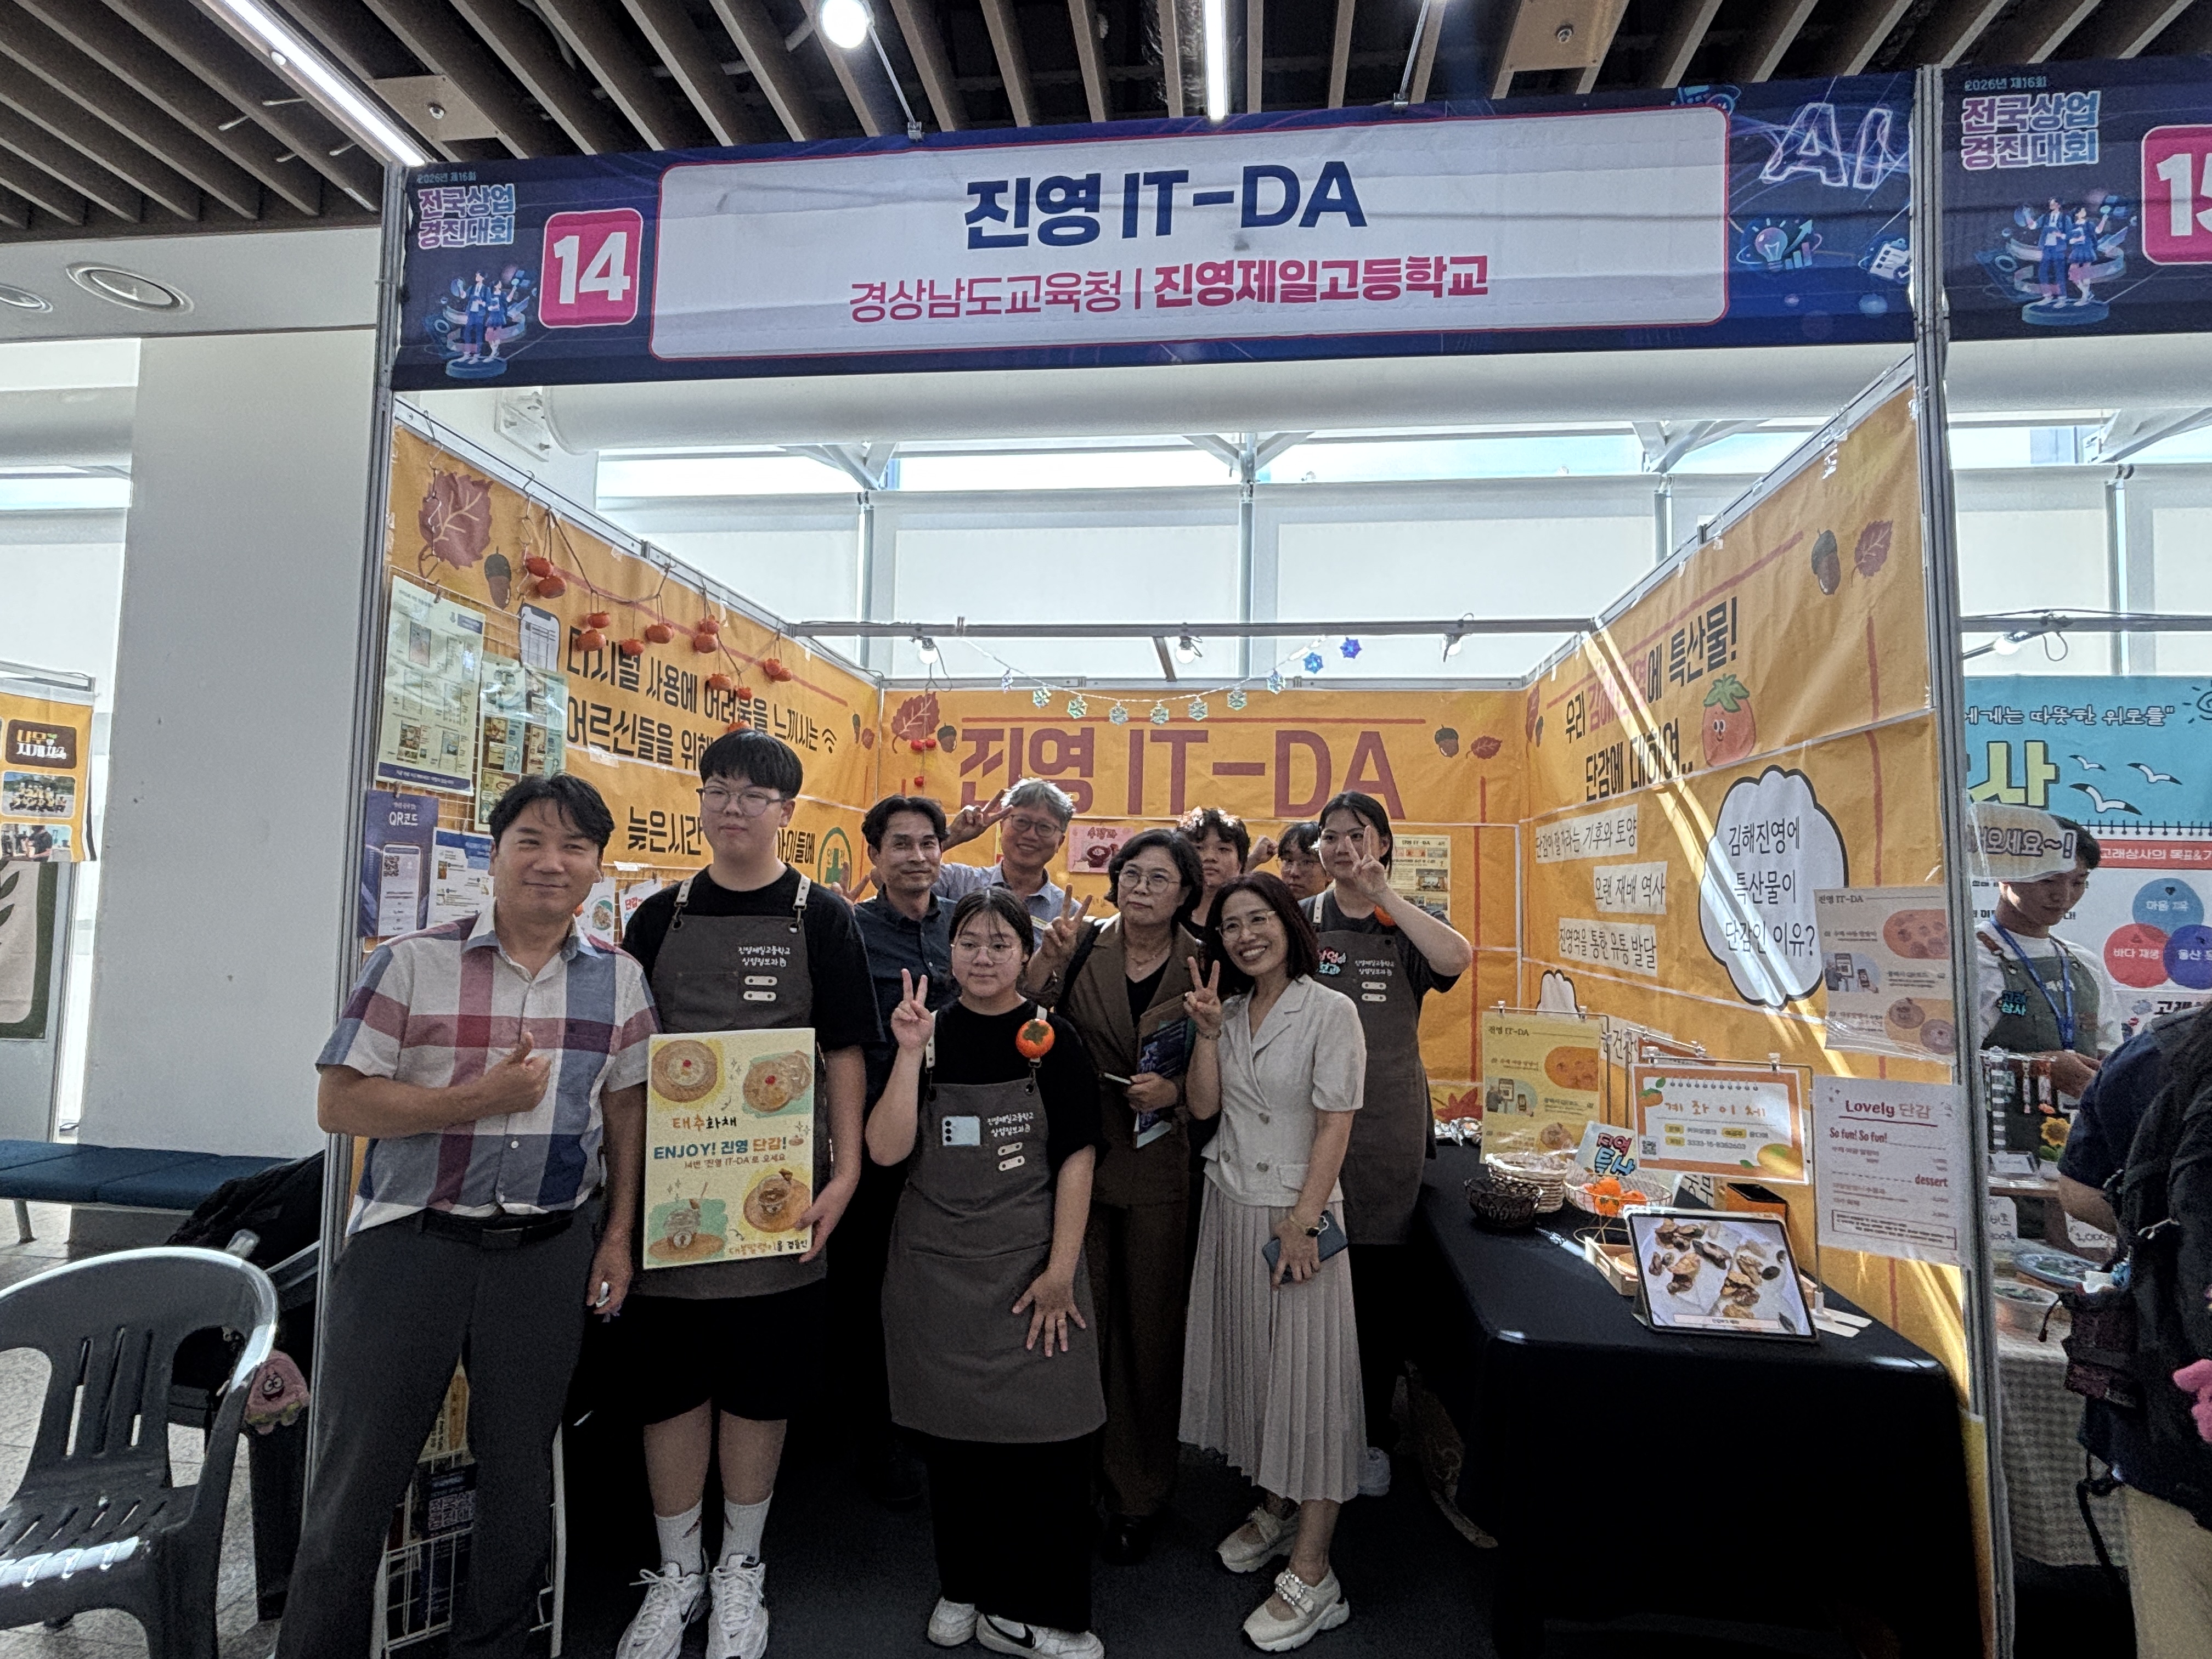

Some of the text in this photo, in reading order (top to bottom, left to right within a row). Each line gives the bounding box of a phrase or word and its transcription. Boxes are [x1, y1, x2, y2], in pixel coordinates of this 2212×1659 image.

[1962, 91, 2101, 134] 전국상업
[1961, 129, 2100, 170] 경진대회
[417, 183, 515, 219] 전국상업
[964, 161, 1368, 250] 진영 IT-DA
[418, 216, 514, 249] 경진대회
[553, 232, 631, 305] 14
[849, 255, 1489, 324] 경상남도교육청 진영제일고등학교
[1566, 691, 1585, 743] 우리
[1669, 596, 1737, 687] 특산물!
[646, 656, 697, 714] 사용에
[774, 704, 818, 752] 느끼시는
[2030, 704, 2097, 725] 따뜻한
[567, 696, 674, 766] 어르신들을
[960, 727, 1406, 820] 진영 IT-DA
[1586, 742, 1624, 802] 단감에
[389, 811, 418, 826] QR코드
[1728, 815, 1800, 857] 김해진영에
[1536, 832, 1554, 858] 단감이
[1561, 827, 1581, 853] 자라는
[1583, 819, 1613, 850] 기후와
[1615, 815, 1637, 848] 토양
[2101, 848, 2166, 860] 고래상사의
[1595, 872, 1666, 907] 오랜 재배 역사
[1734, 869, 1796, 905] 특산물이
[1818, 894, 1864, 905] 진영 IT-DA
[737, 945, 791, 956] 진영제일고등학교
[1560, 926, 1588, 957] 진영역을
[1611, 932, 1629, 966] 유통
[1631, 934, 1657, 970] 발달
[1725, 919, 1815, 958] 단감인 이유?
[2113, 948, 2136, 959] 바다
[1488, 1025, 1530, 1037] 진영 IT-DA
[672, 1113, 737, 1132] 태추화채
[1845, 1100, 1932, 1119] Lovely 단감
[653, 1137, 787, 1160] ENJOY! 진영 단감!
[1596, 1132, 1633, 1156] 지역
[1830, 1127, 1888, 1143] So fun! So fun!
[684, 1159, 701, 1170] 14번
[762, 1153, 786, 1163] 오세요
[1915, 1173, 1948, 1187] dessert
